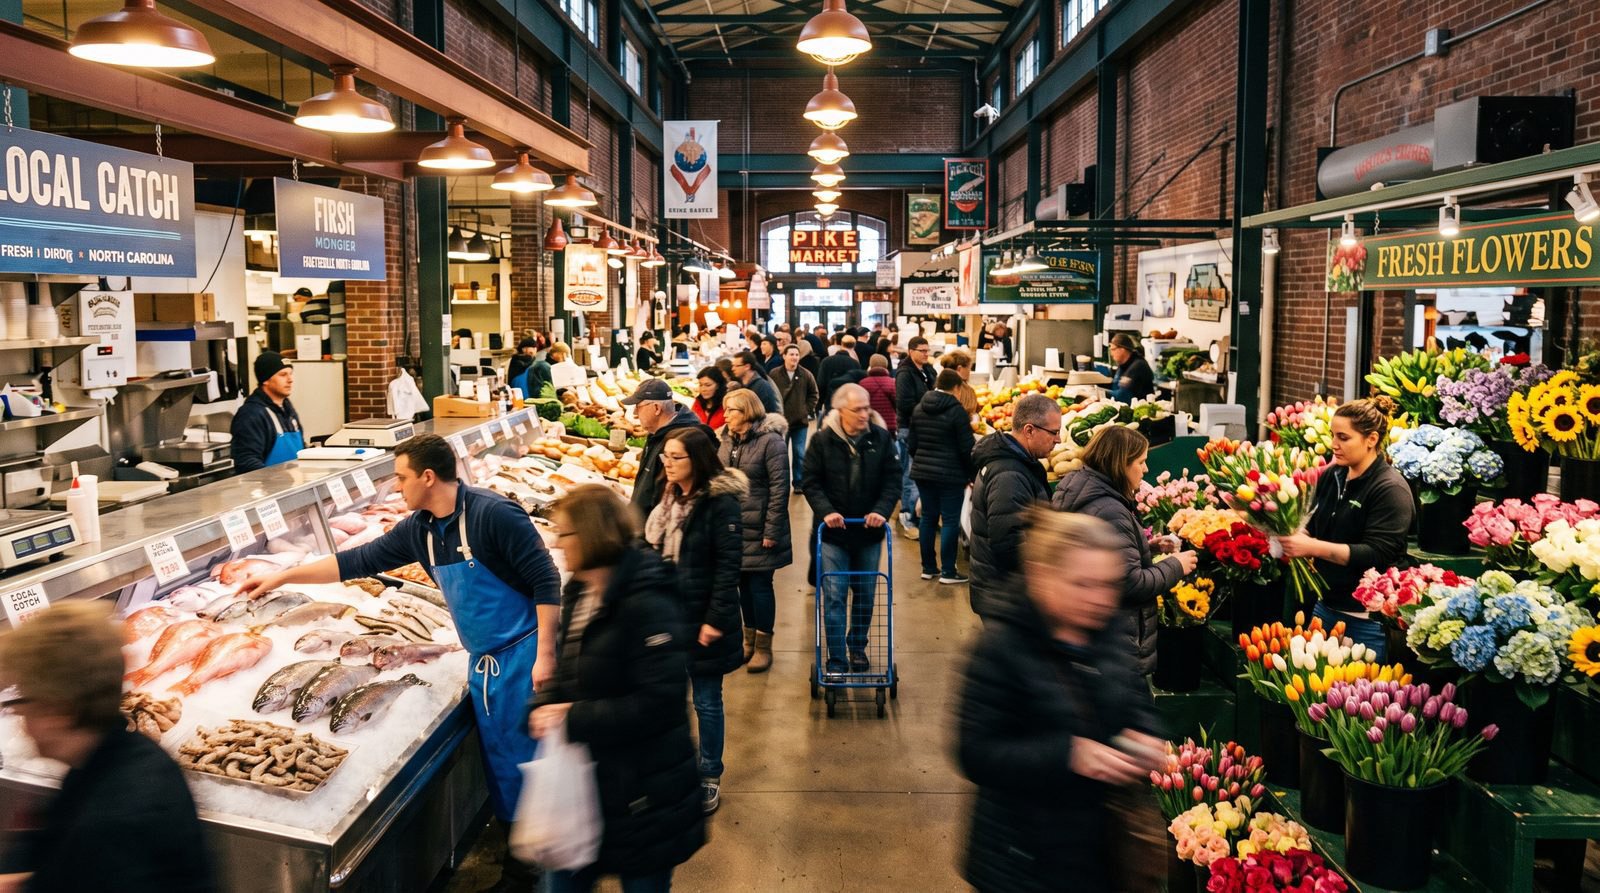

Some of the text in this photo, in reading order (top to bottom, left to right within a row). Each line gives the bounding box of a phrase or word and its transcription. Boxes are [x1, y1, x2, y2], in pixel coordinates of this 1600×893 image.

[97, 161, 180, 221] CATCH
[314, 196, 356, 236] FIRSH
[315, 236, 356, 252] MONGIER
[792, 230, 857, 247] PIKE
[1, 244, 34, 258] FRESH
[89, 249, 125, 263] NORTH
[127, 251, 175, 265] CAROLINA
[790, 249, 859, 263] MARKET
[1376, 225, 1593, 278] FRESH FLOWERS
[13, 596, 41, 611] COTCH
